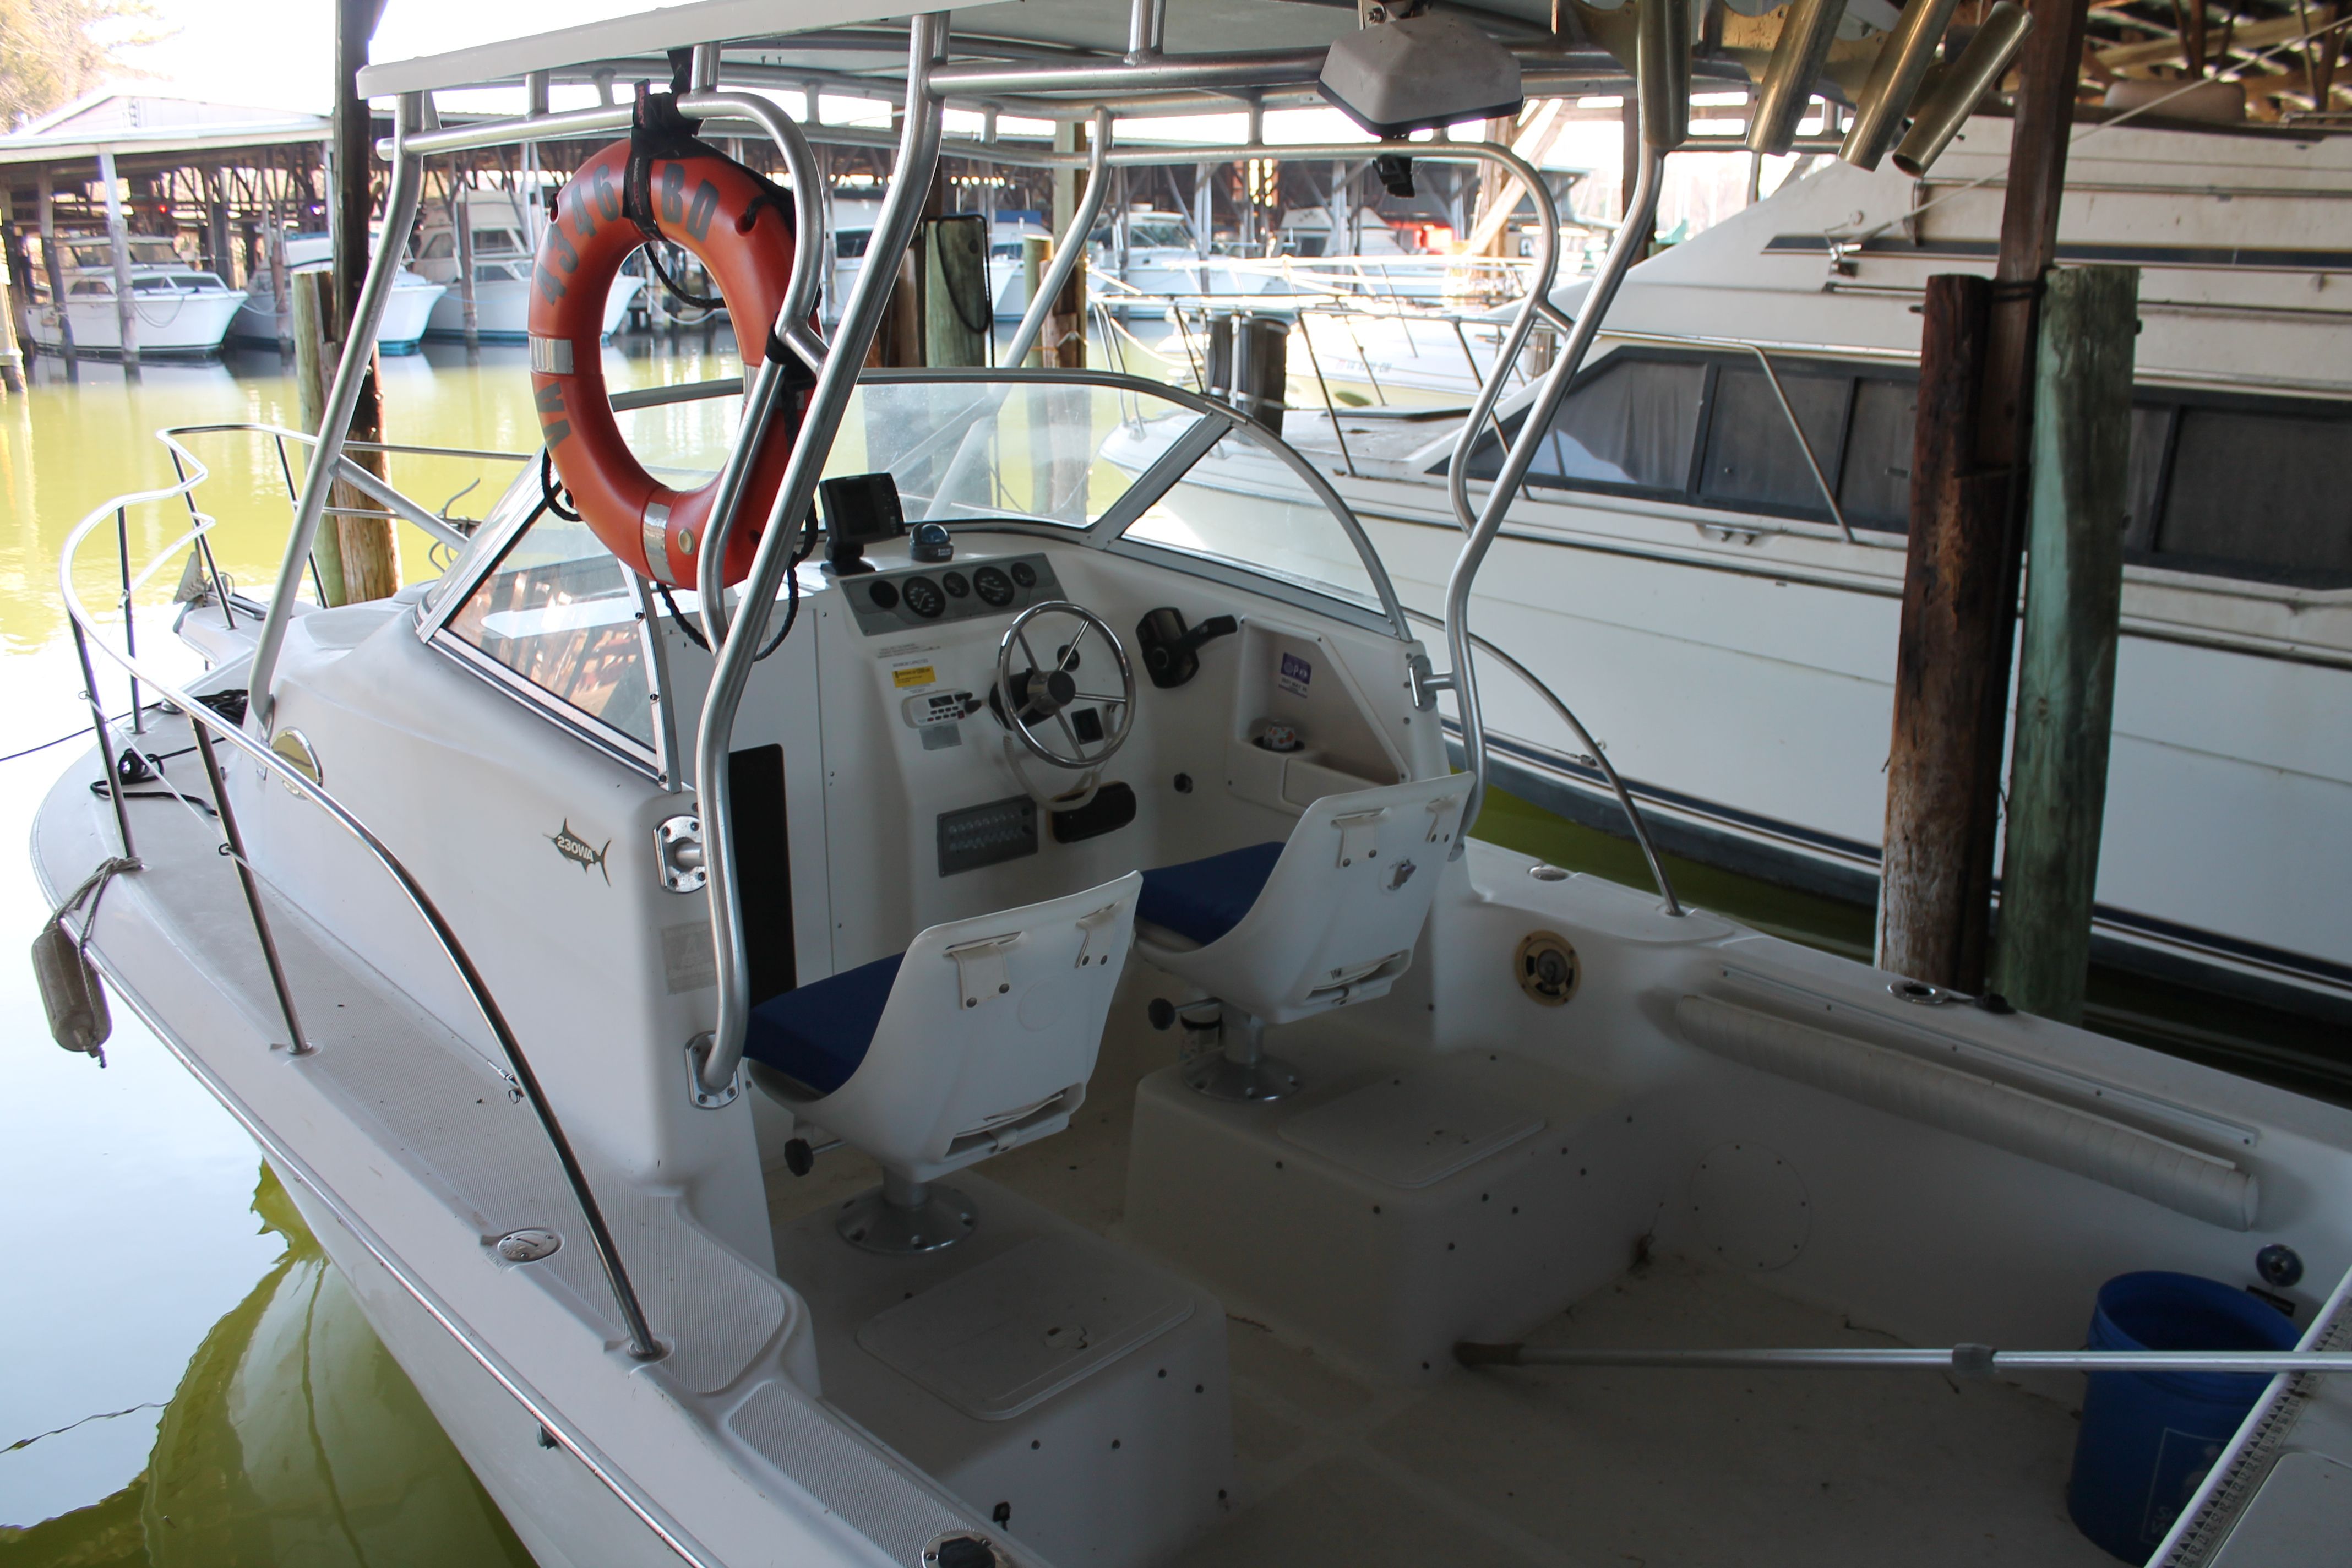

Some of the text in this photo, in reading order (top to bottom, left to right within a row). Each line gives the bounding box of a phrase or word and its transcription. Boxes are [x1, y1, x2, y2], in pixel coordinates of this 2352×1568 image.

[536, 164, 620, 306] 4346
[662, 164, 719, 243] BD
[557, 835, 594, 862] 230WA
